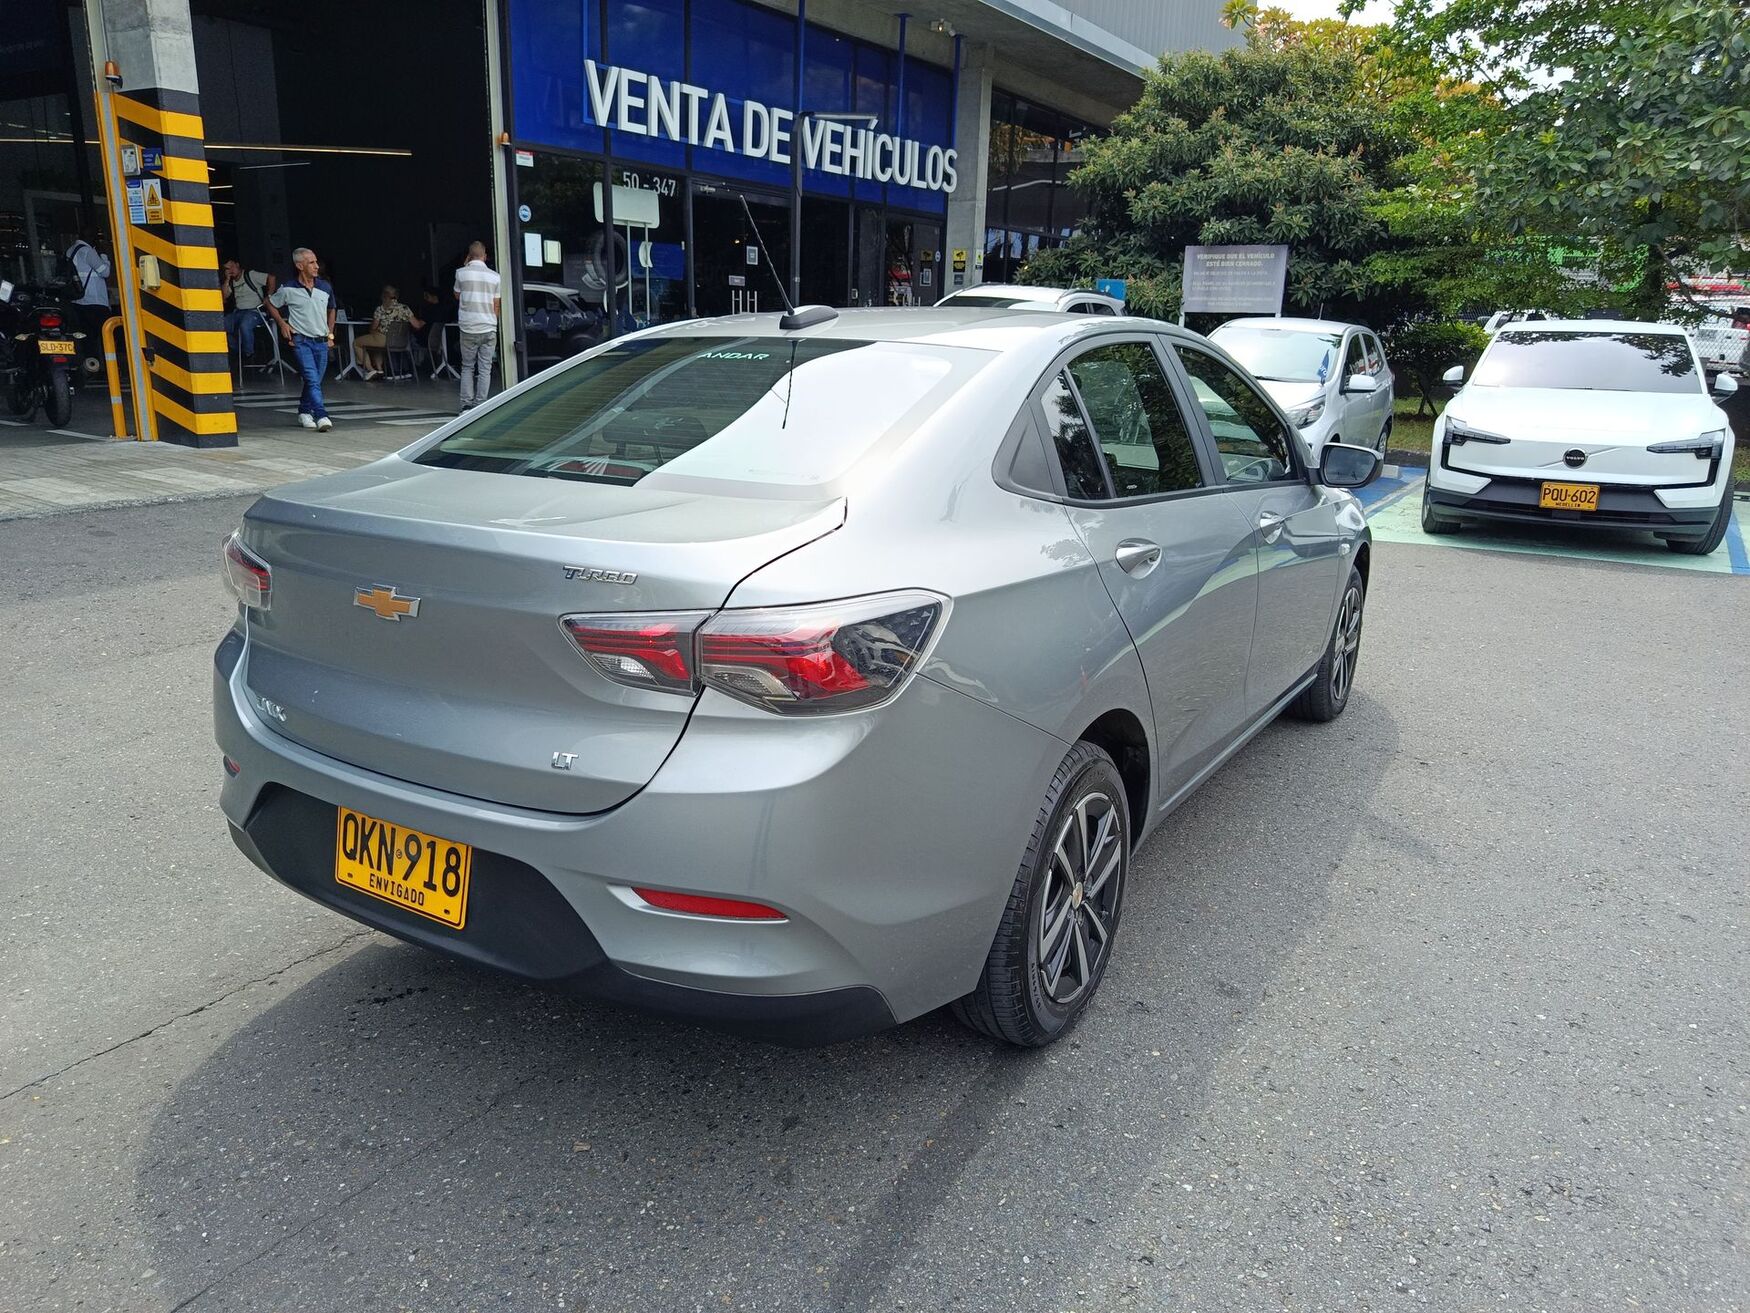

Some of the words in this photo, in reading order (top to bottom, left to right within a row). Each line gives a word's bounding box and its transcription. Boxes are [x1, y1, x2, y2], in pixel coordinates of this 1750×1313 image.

[584, 59, 735, 153] VENTA
[743, 99, 794, 165] DE
[802, 116, 958, 194] VEHÍCULOS
[623, 171, 640, 190] 50
[653, 176, 677, 198] 347
[696, 352, 770, 360] ANDAR
[562, 565, 639, 586] TURBO
[551, 751, 580, 770] LT
[369, 873, 425, 907] ENVIGADO
